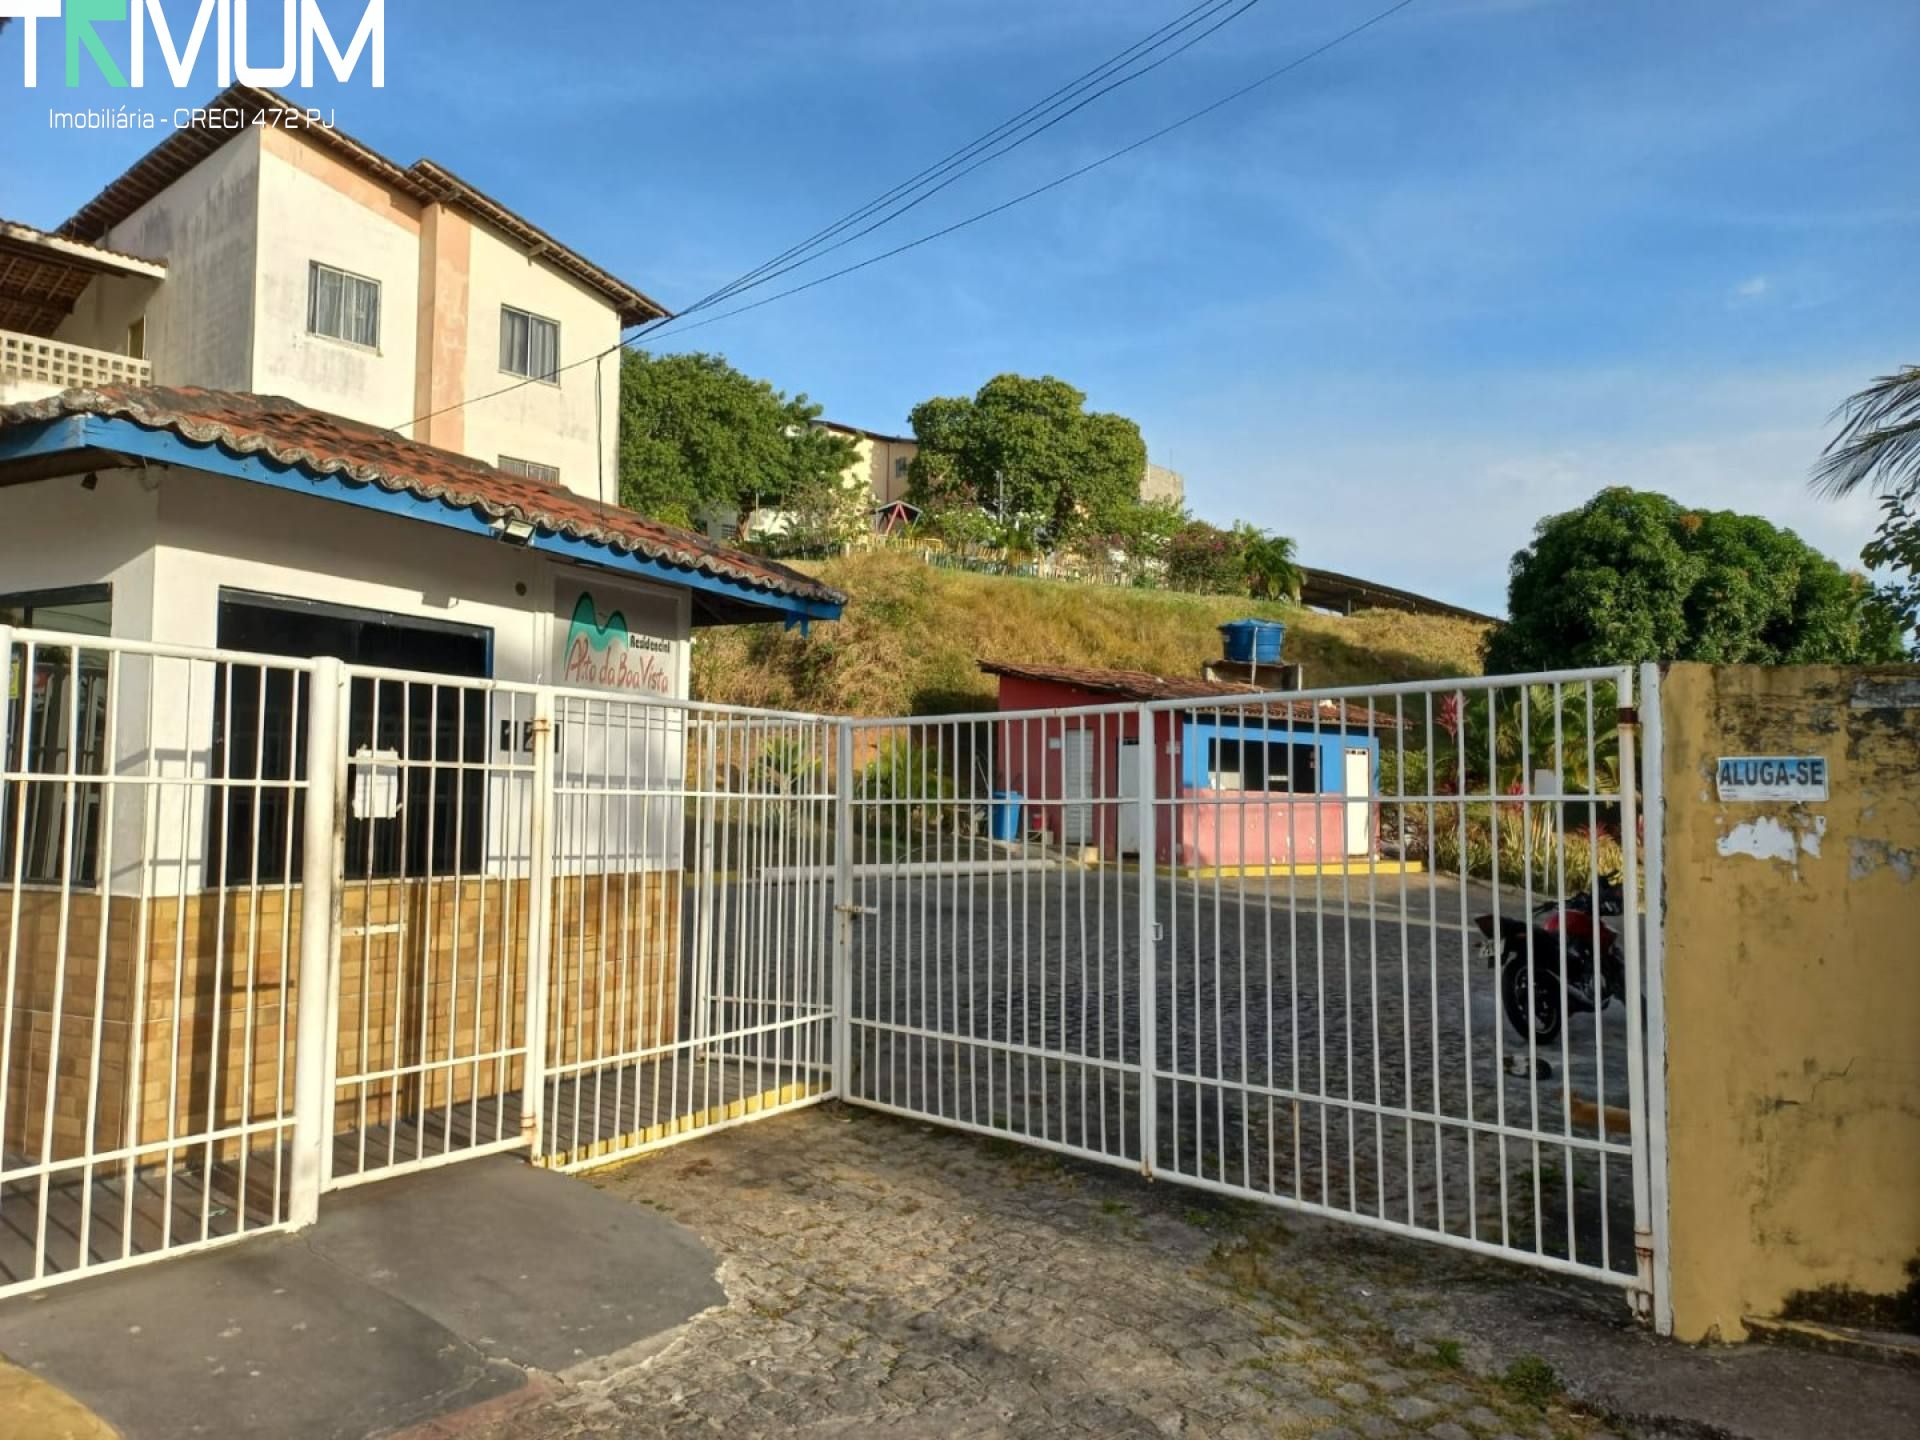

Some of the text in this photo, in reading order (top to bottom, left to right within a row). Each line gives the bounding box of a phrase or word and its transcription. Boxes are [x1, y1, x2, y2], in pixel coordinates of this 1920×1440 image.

[630, 634, 671, 653] Residencial
[599, 645, 616, 686] da
[616, 652, 640, 688] Boa
[639, 655, 670, 693] Vista
[1719, 760, 1823, 786] ALUGA-SE
